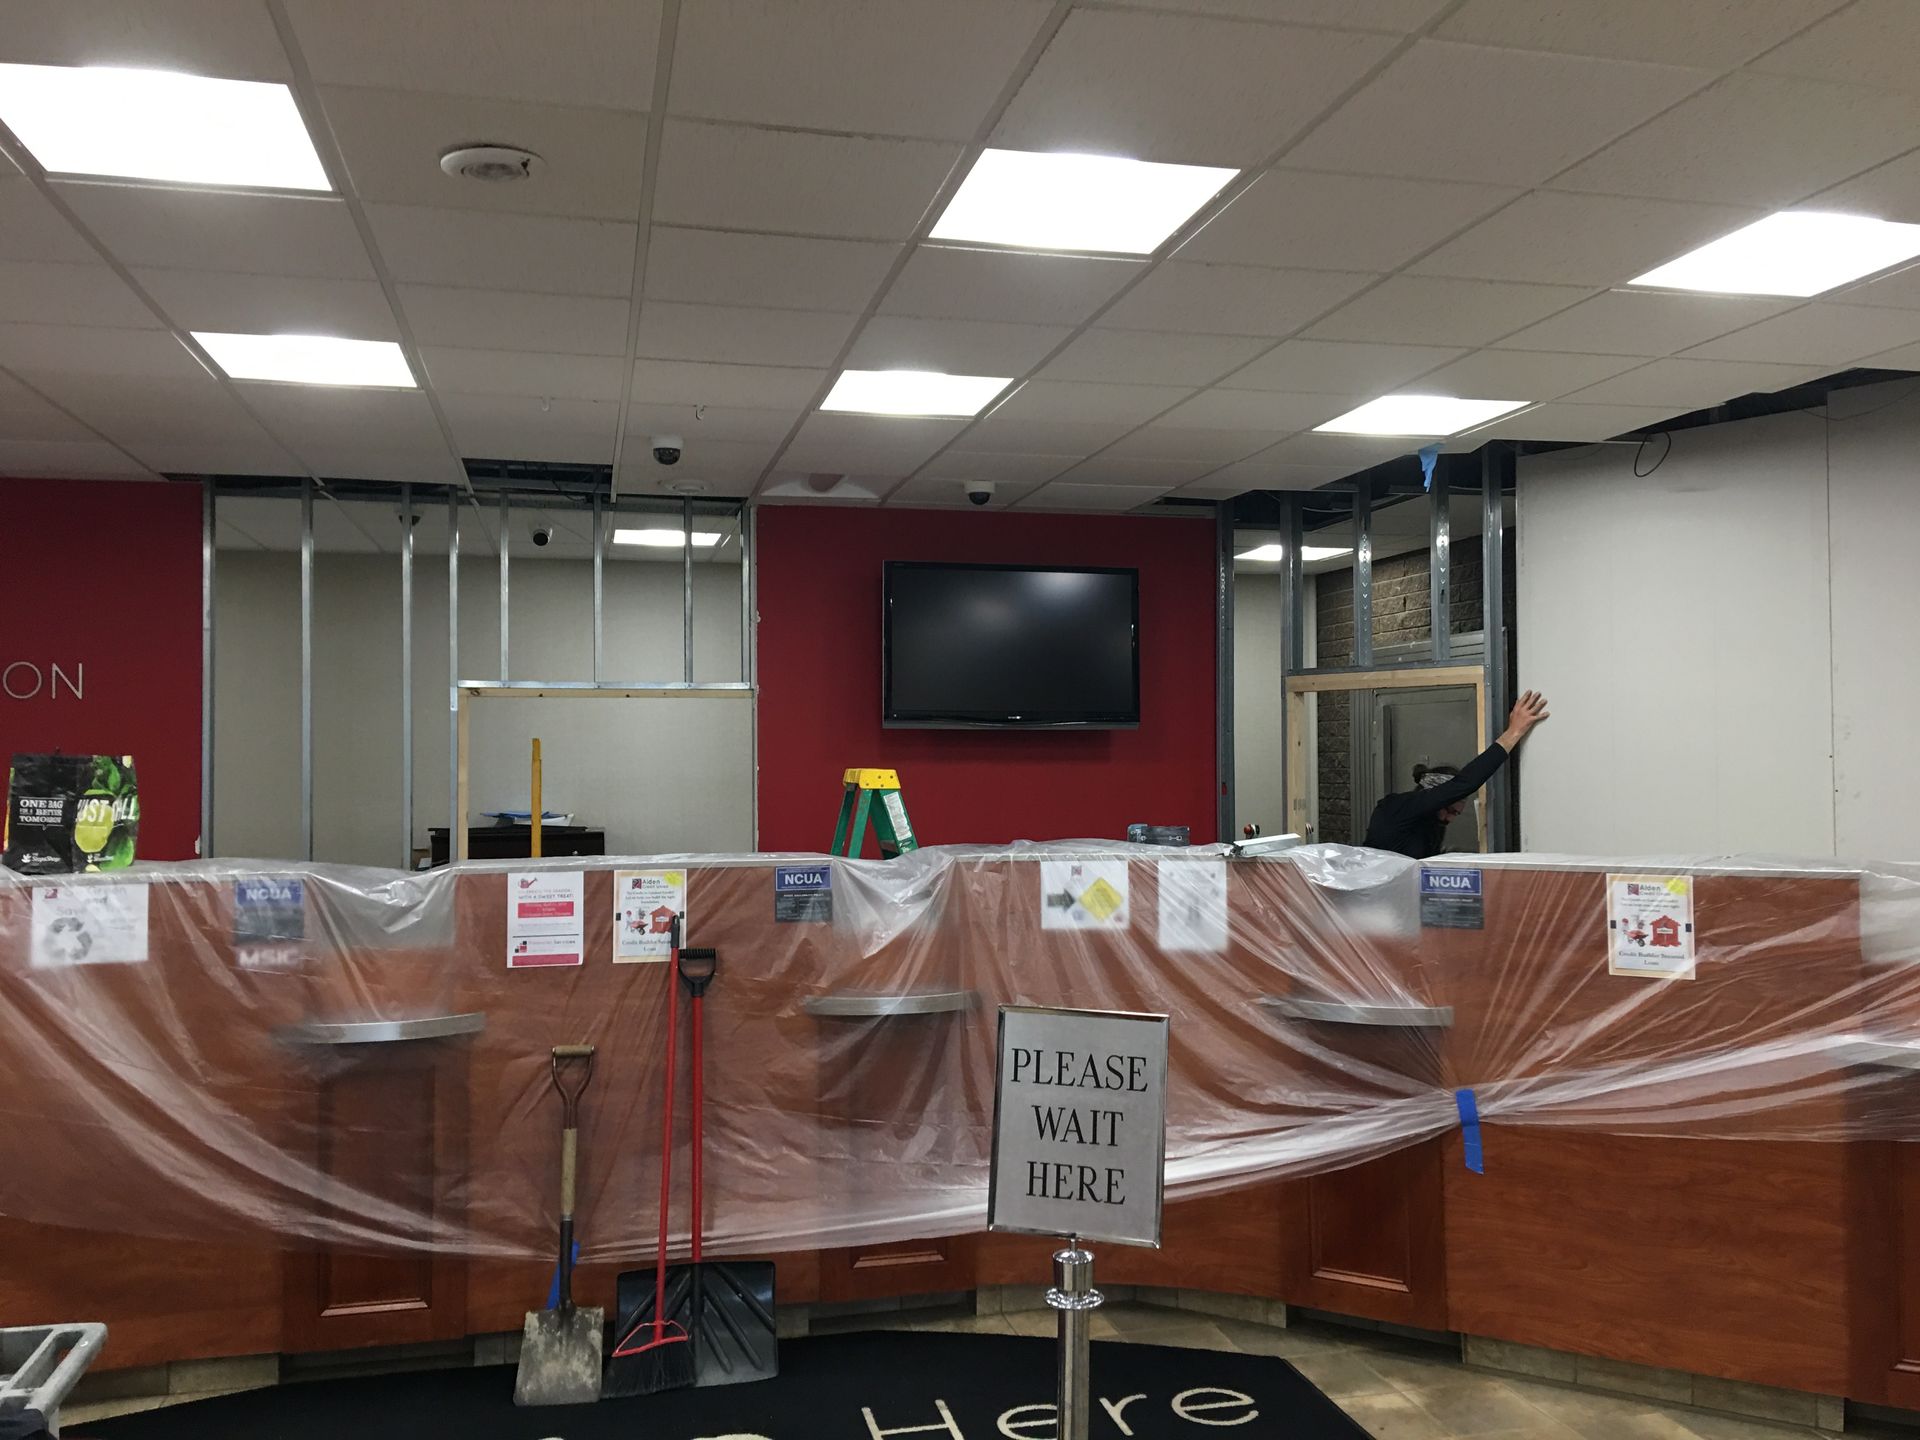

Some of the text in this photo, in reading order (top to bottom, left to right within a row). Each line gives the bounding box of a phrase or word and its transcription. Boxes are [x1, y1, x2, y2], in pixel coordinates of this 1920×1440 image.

[2, 661, 83, 700] ON
[19, 799, 64, 809] ONE BAG
[246, 887, 292, 901] NCUA
[785, 873, 823, 885] NCUA
[1429, 875, 1472, 889] NCUA
[1011, 1048, 1148, 1092] PLEASE
[1031, 1105, 1124, 1146] WAIT
[1026, 1161, 1126, 1205] HERE
[861, 1387, 1259, 1440] Here
